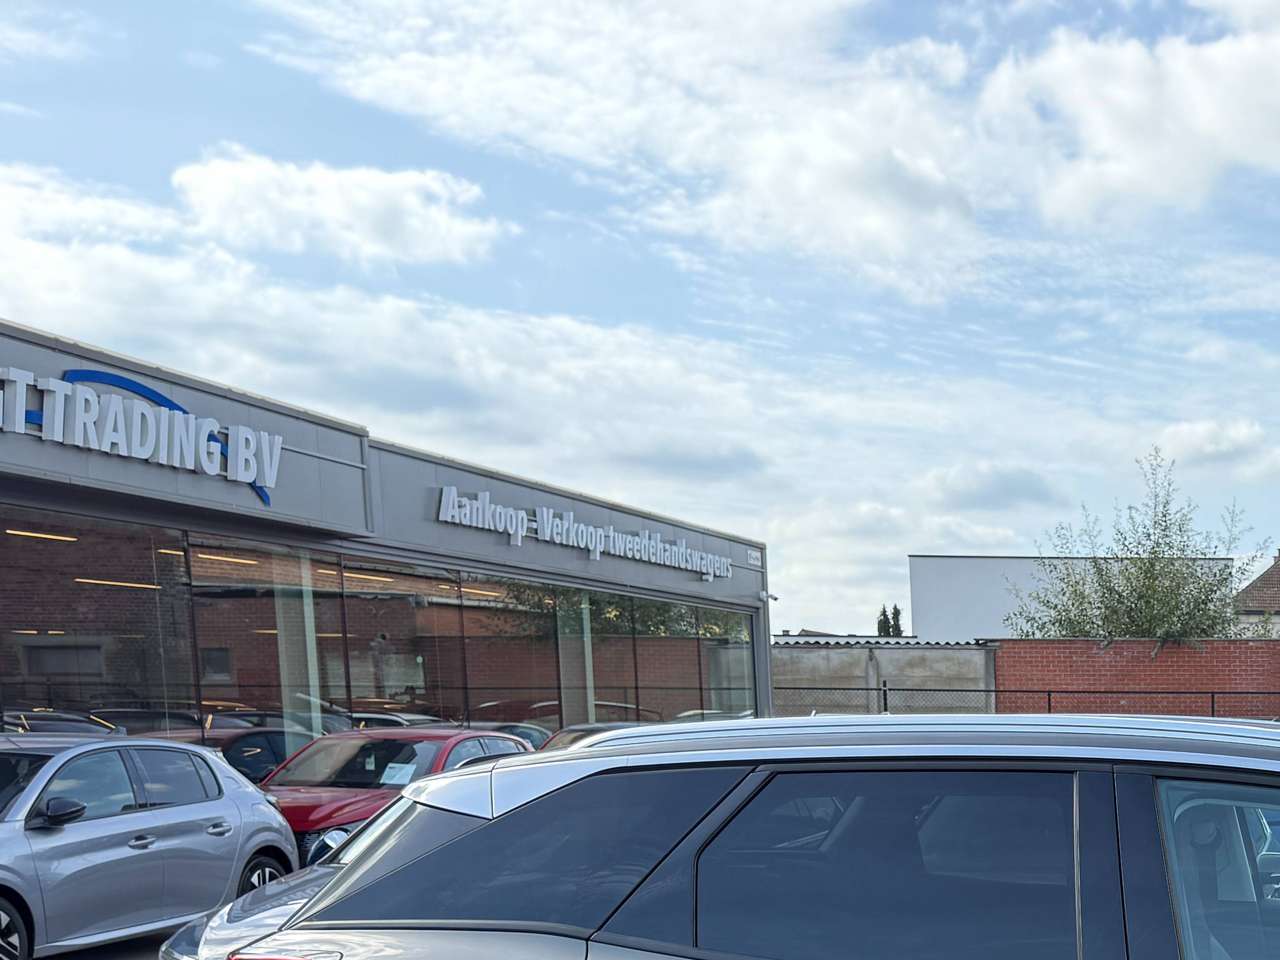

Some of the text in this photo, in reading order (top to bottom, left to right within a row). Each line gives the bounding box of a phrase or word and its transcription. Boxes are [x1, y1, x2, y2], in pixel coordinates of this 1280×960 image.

[0, 366, 283, 488] T TRADING BV
[438, 486, 529, 547] Aankoop
[535, 506, 604, 560] Verkoop
[606, 525, 733, 582] tweedehandswagens
